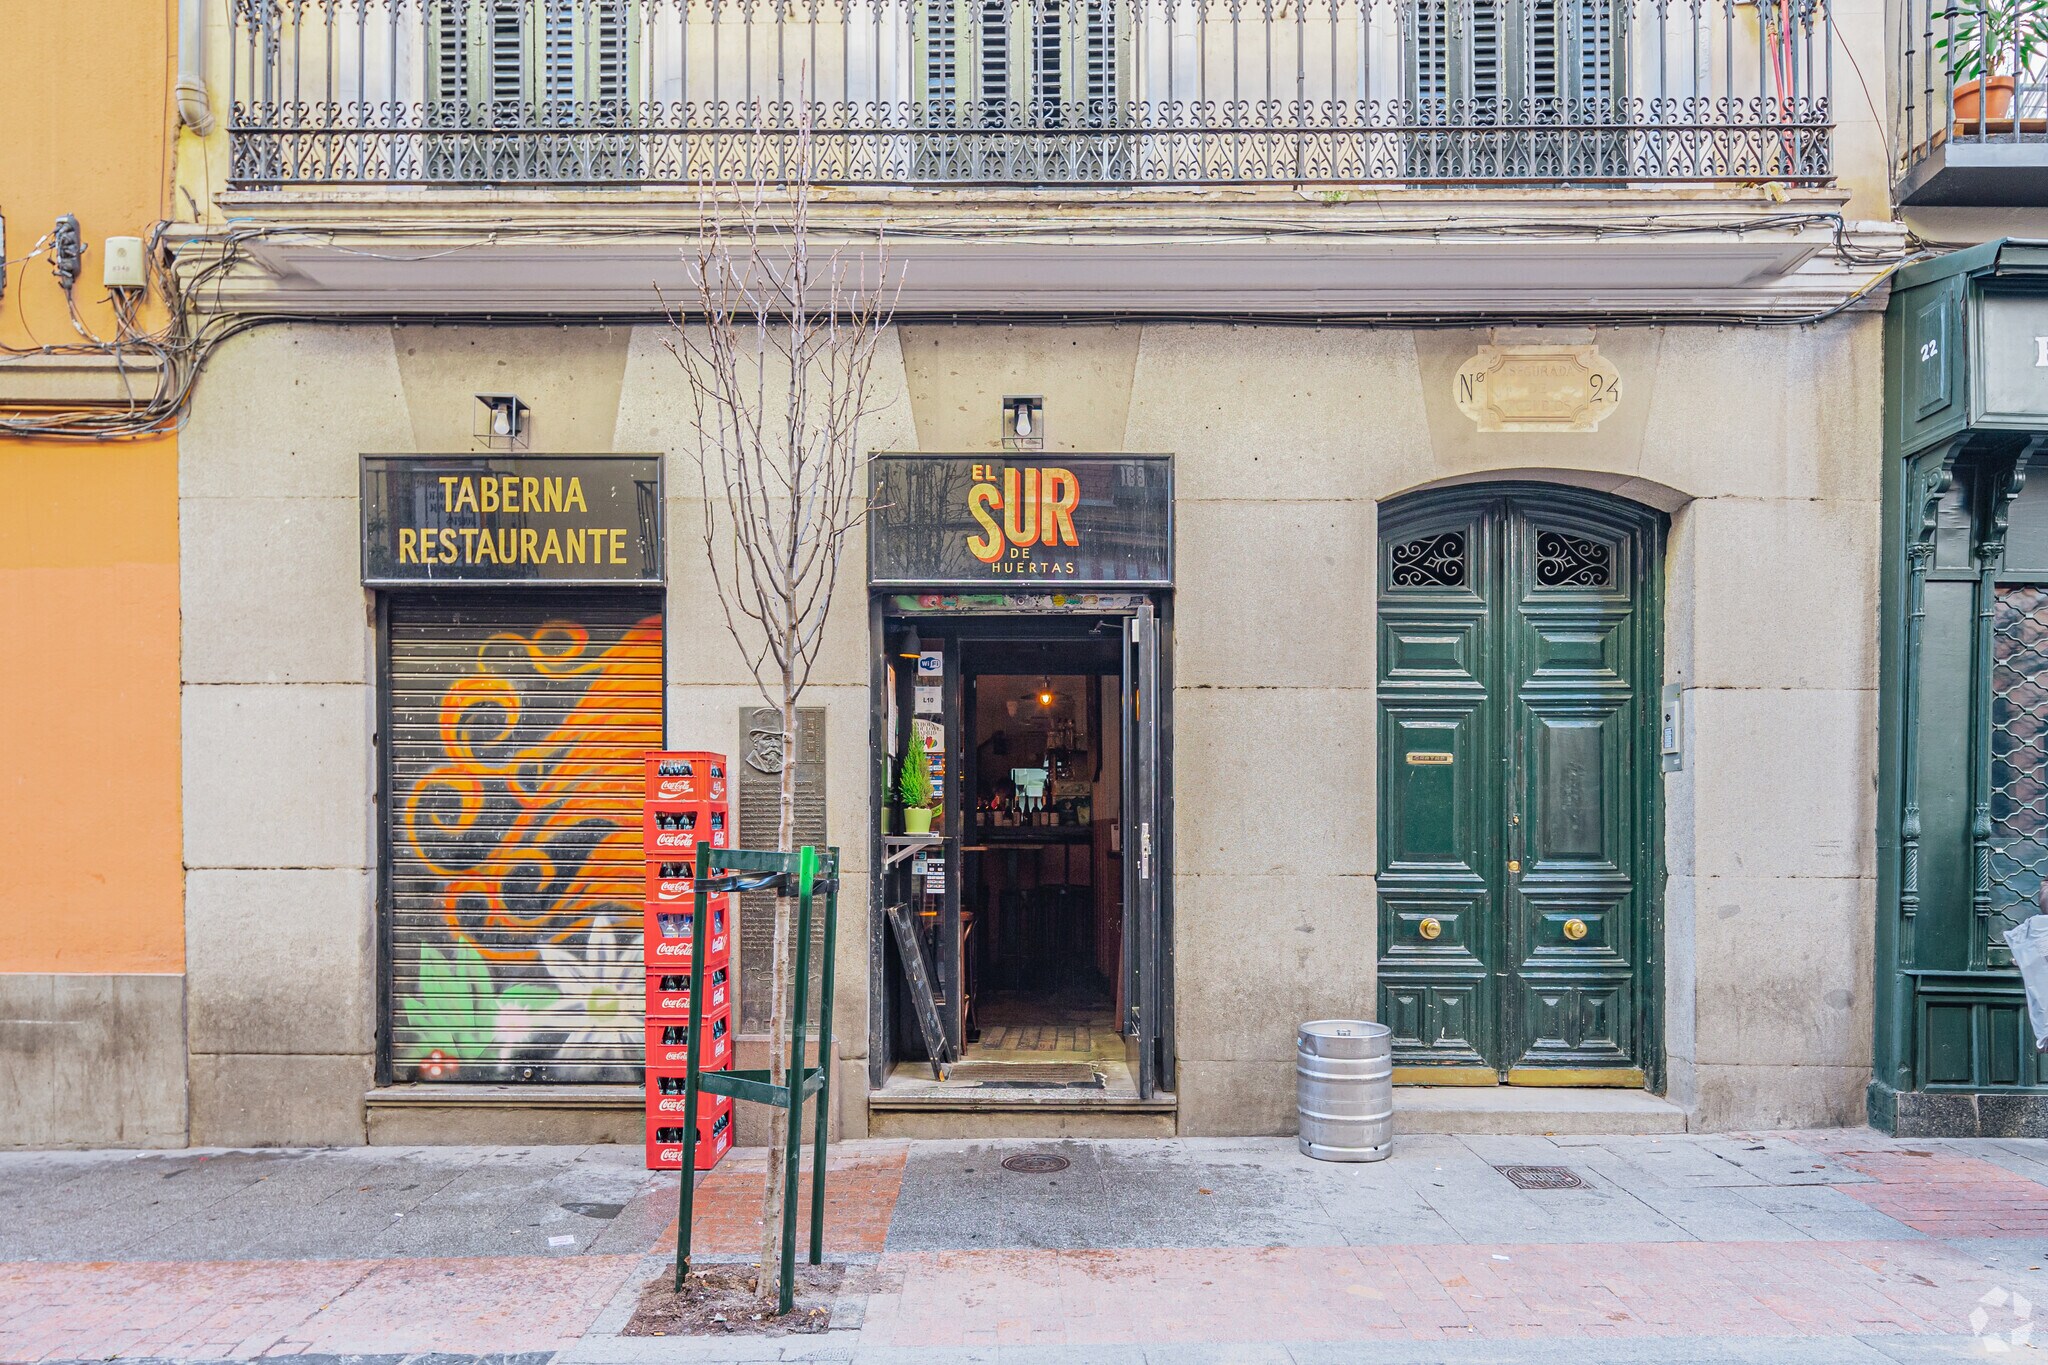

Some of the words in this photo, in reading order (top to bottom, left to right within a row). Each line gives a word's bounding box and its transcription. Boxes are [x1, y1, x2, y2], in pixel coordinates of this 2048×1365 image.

[1920, 339, 1938, 362] 22
[1589, 374, 1619, 403] 24
[972, 464, 997, 481] EL
[439, 477, 588, 513] TABERNA
[966, 467, 1080, 563] SUR
[399, 528, 628, 564] RESTAURANTE
[1010, 548, 1031, 559] DE
[992, 562, 1075, 574] HUERTAS
[661, 781, 690, 790] Coca-Cola
[656, 833, 694, 846] Coca-Cola
[661, 882, 690, 891] Coca-Cola
